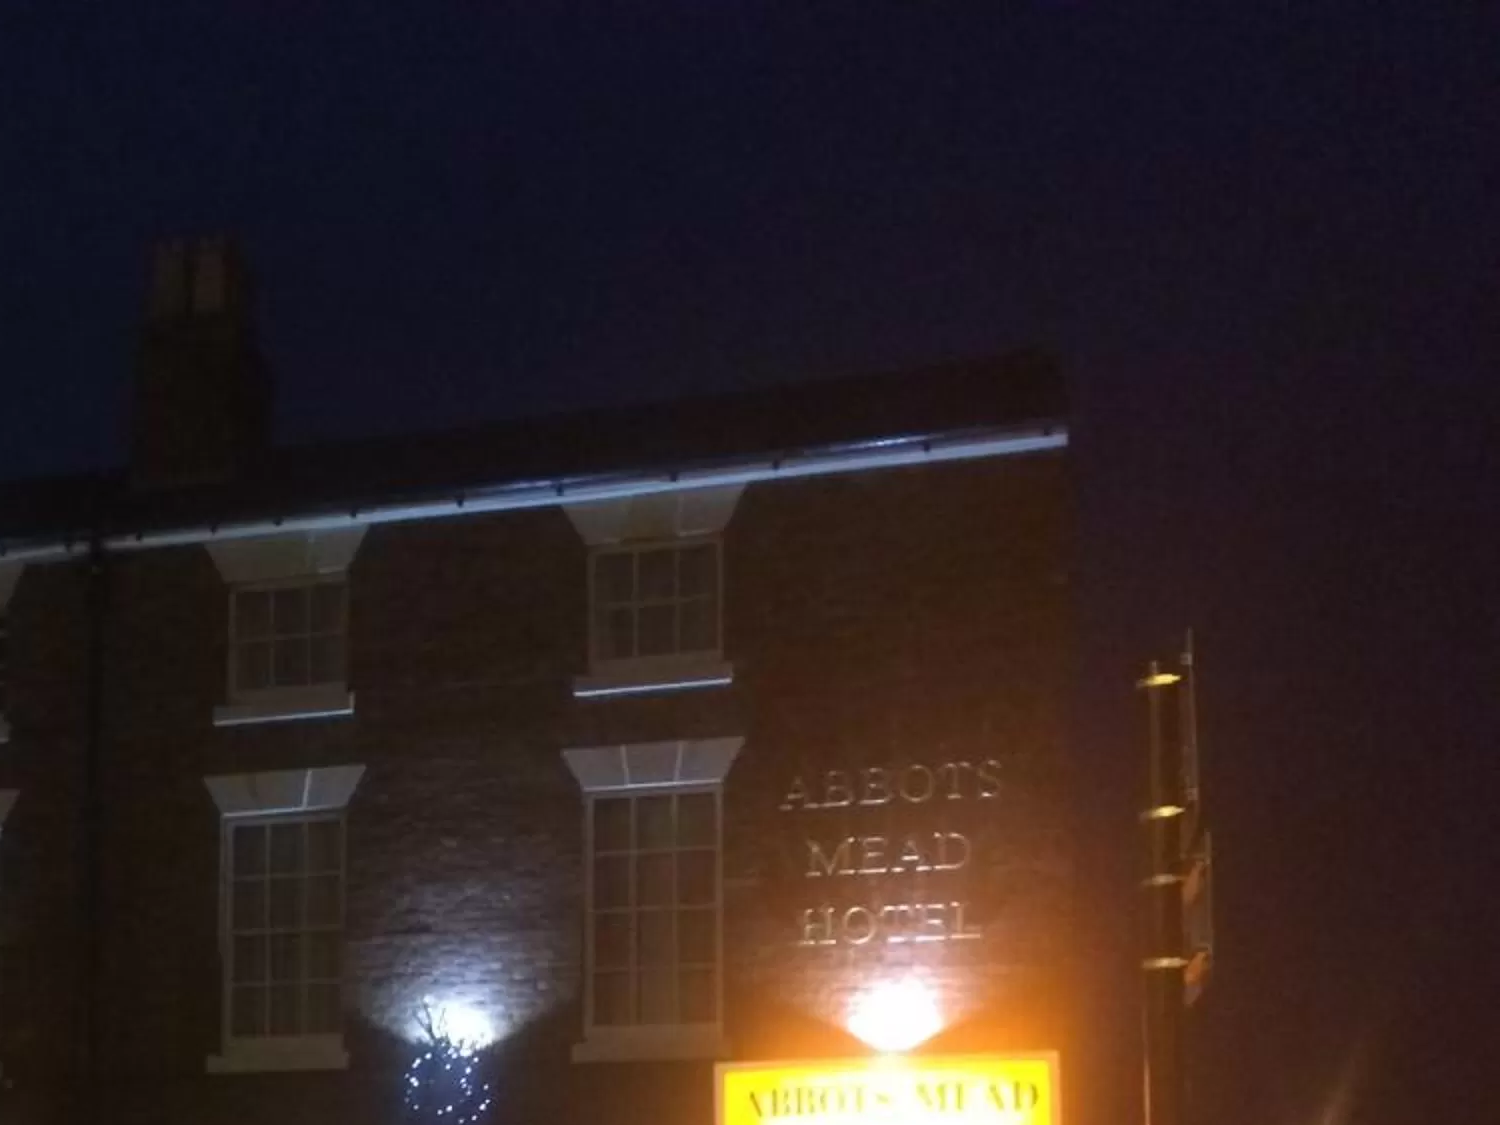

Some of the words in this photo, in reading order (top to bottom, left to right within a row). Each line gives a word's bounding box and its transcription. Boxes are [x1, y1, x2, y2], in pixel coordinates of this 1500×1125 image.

[780, 758, 1004, 810] ABBOTS
[804, 832, 973, 877] MEAD
[798, 899, 982, 946] HOTEL
[747, 1084, 893, 1119] ABBOTS
[915, 1079, 1040, 1113] MEAD
